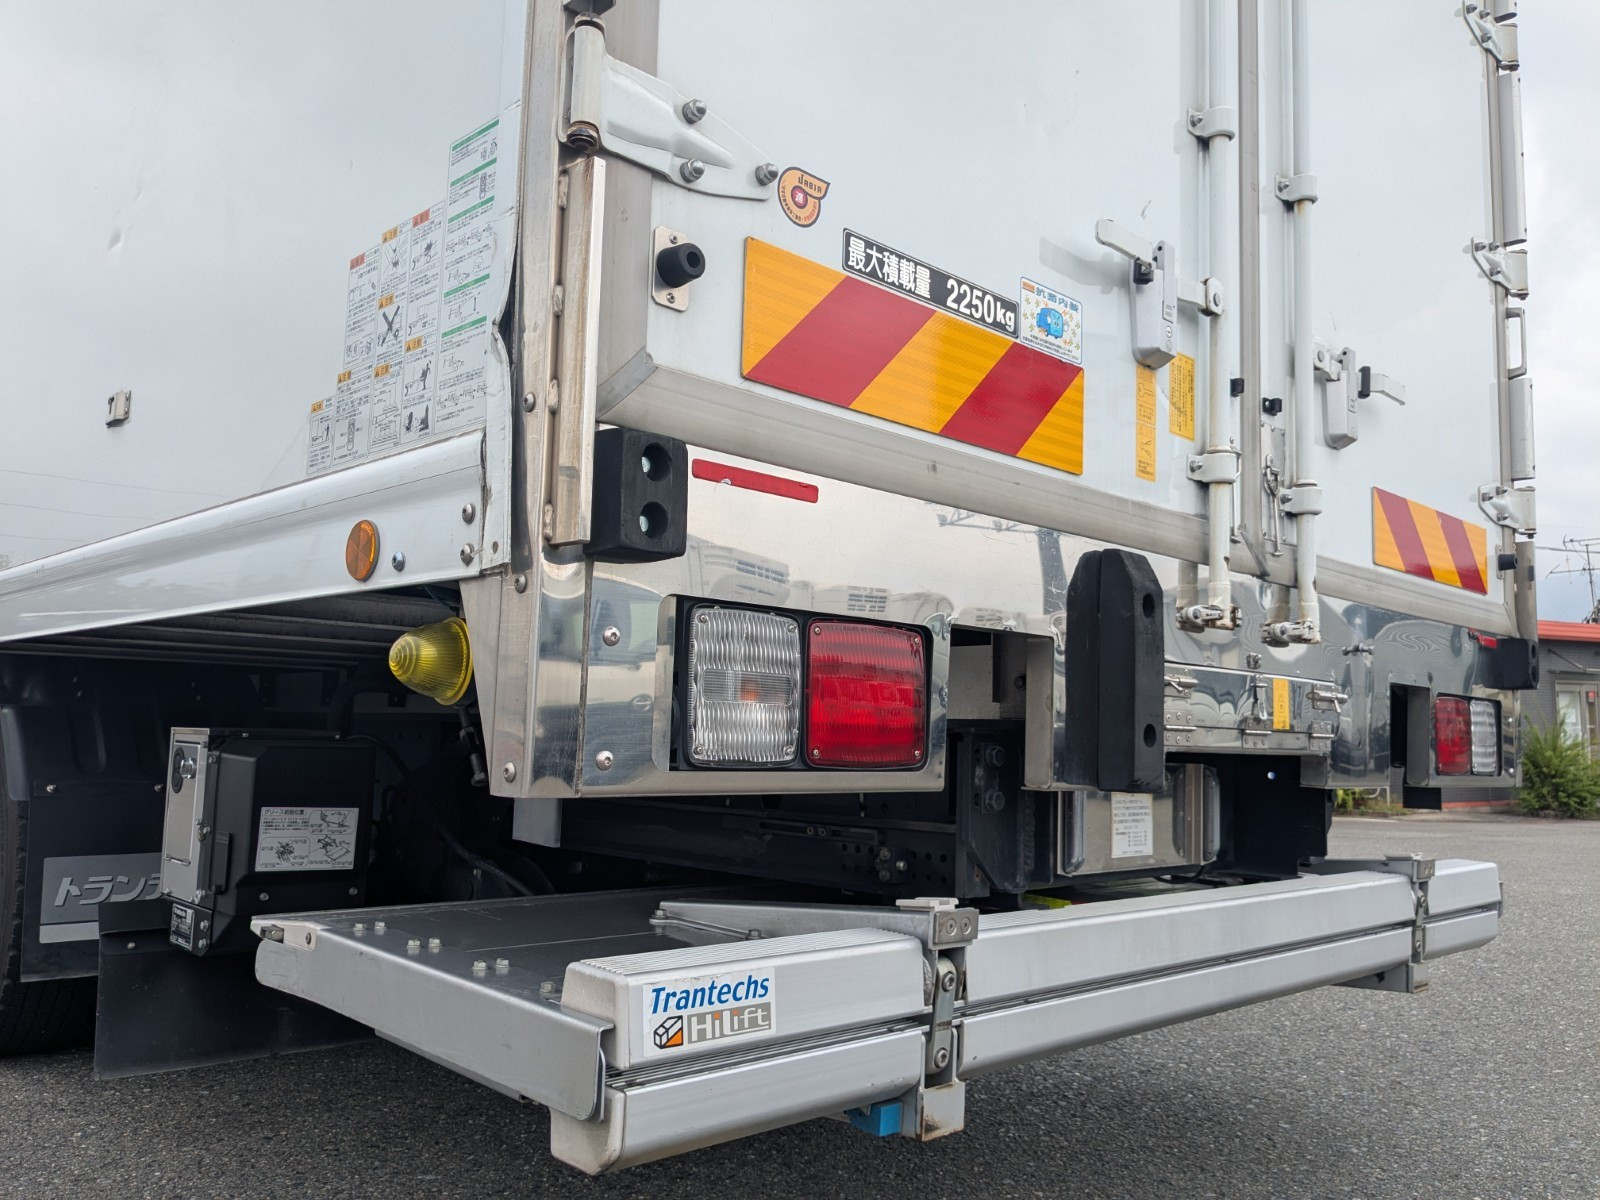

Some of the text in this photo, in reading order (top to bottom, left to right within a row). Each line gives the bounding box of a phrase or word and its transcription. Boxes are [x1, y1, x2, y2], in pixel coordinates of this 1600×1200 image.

[848, 236, 931, 299] 最大積載量
[652, 975, 769, 1014] Trantechs
